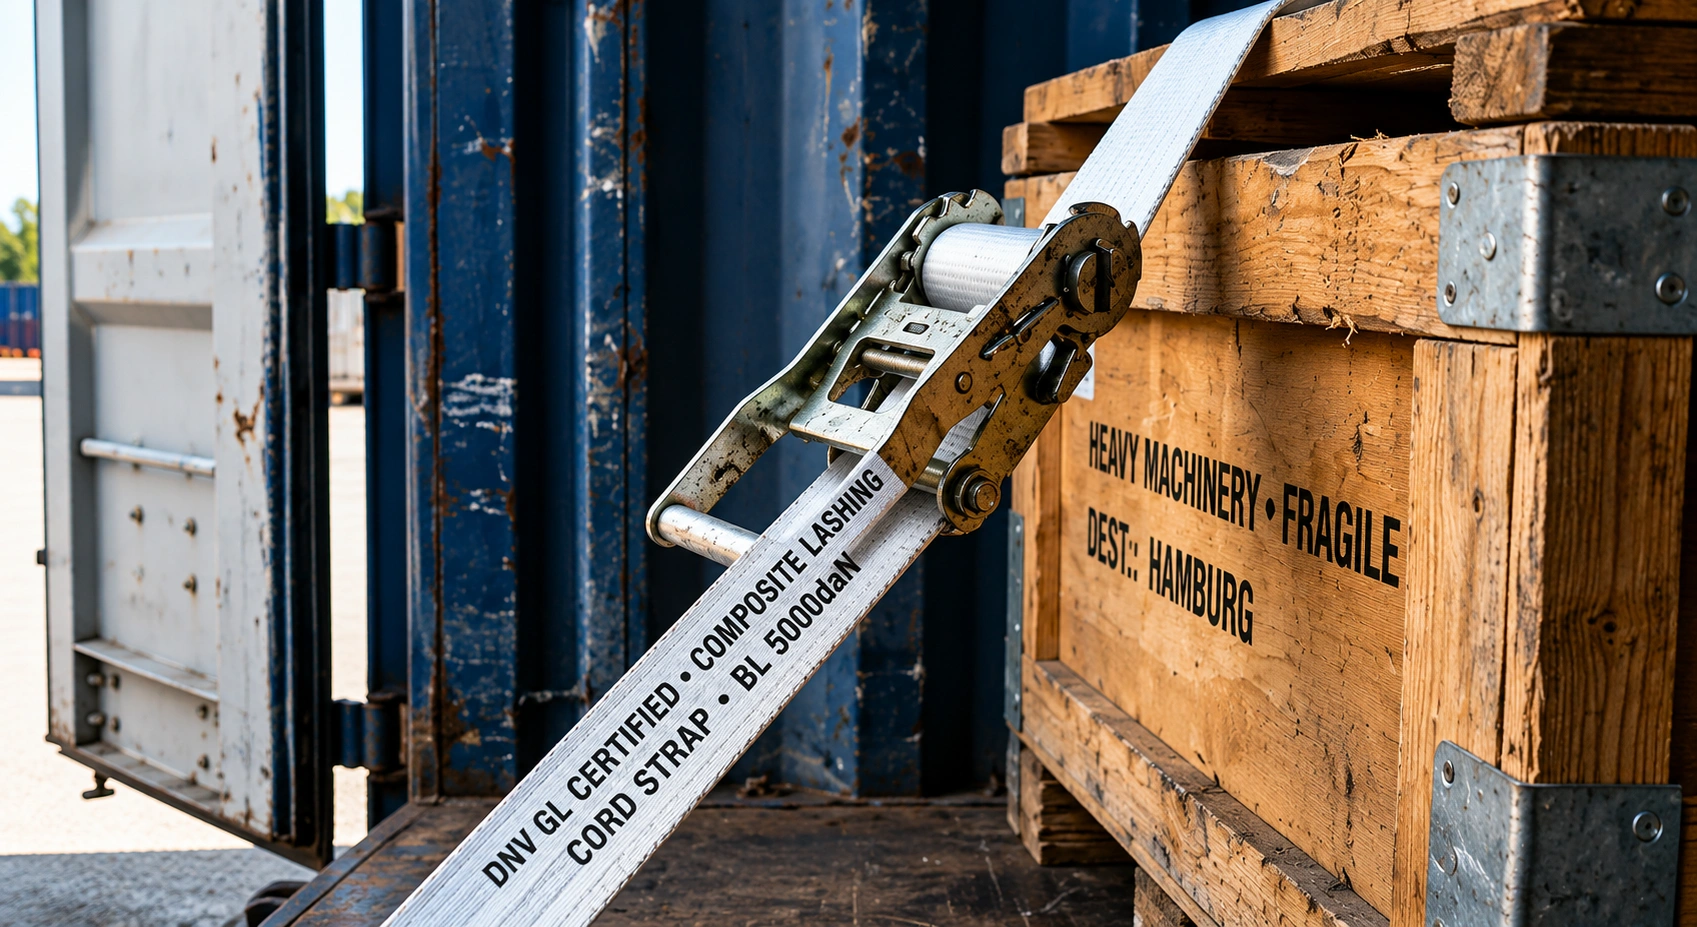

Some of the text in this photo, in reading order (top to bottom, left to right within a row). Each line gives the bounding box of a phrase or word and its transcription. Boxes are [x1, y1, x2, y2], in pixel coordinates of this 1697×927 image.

[1089, 421, 1139, 484] HEAVY
[1144, 437, 1262, 532] MACHINERY
[1281, 482, 1401, 589] FRAGILE
[1148, 536, 1254, 646] HAMBURG
[482, 827, 537, 889] DNV
[533, 800, 573, 835] GL
[567, 682, 680, 801] CERTIFIED
[690, 549, 807, 671] COMPOSITE
[799, 468, 884, 557] LASHING
[566, 792, 638, 866] CORD
[633, 708, 711, 796] STRAP
[730, 655, 772, 692] BL
[764, 550, 862, 656] 5000daN
